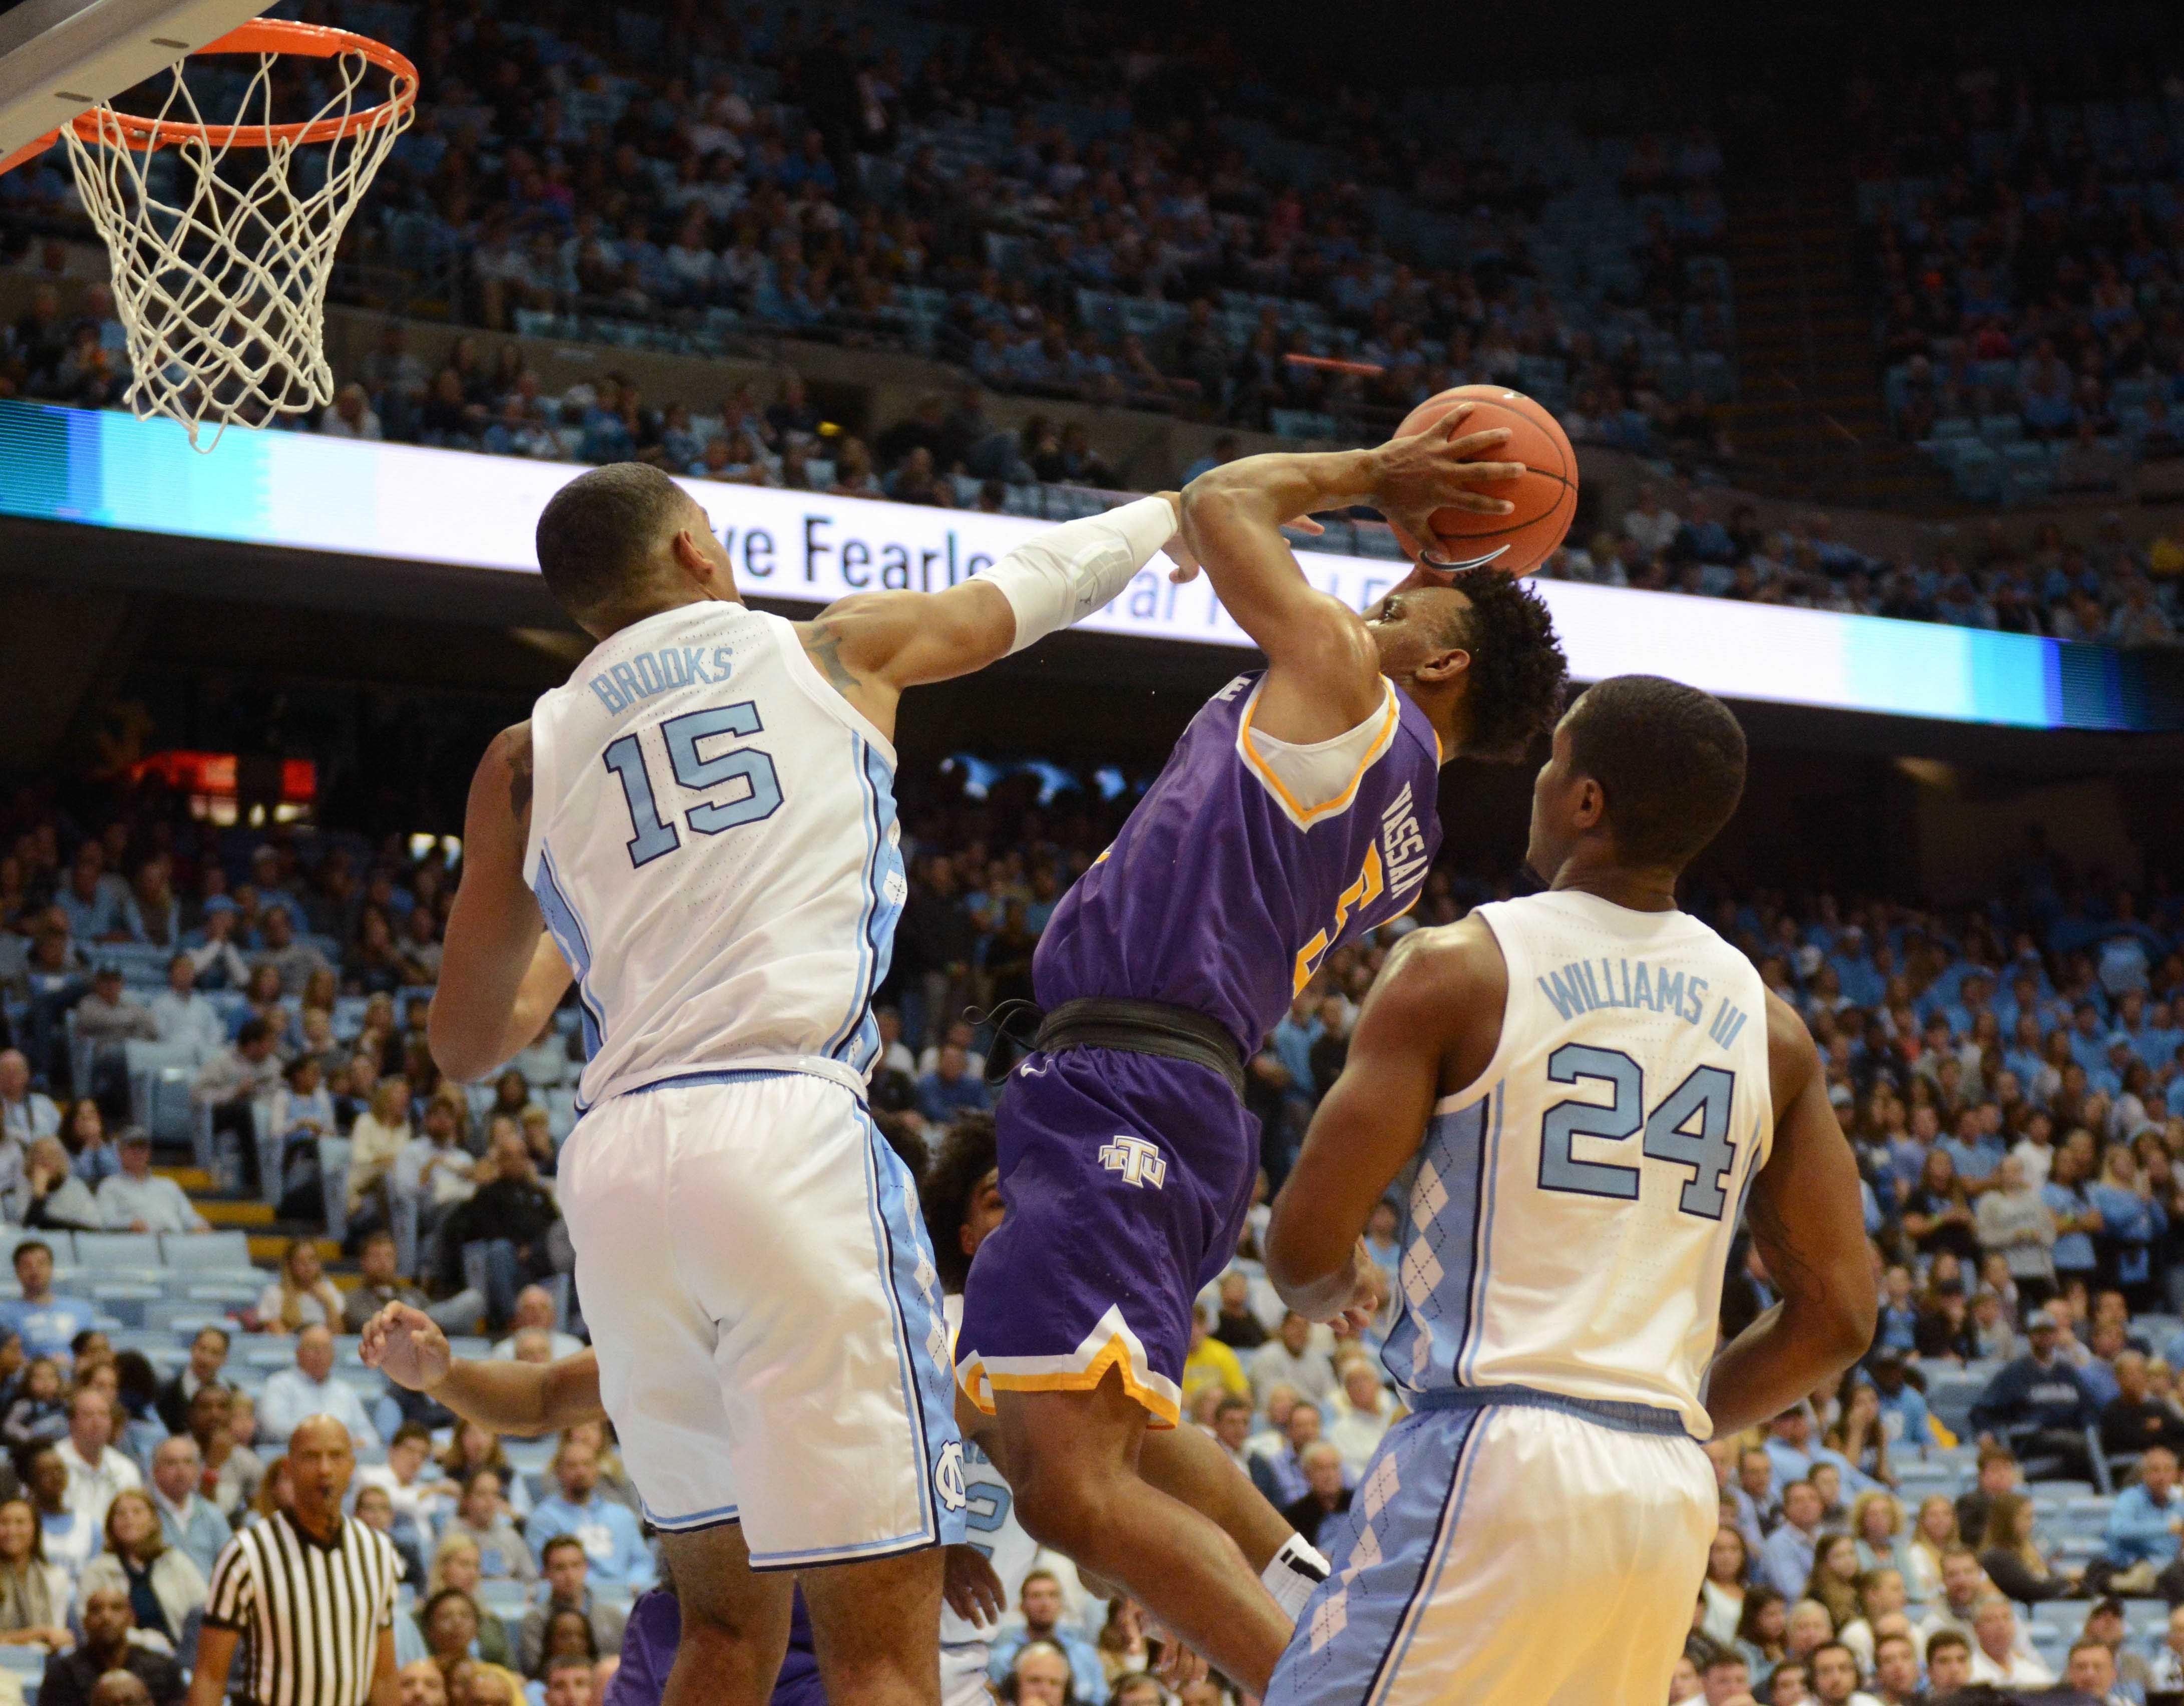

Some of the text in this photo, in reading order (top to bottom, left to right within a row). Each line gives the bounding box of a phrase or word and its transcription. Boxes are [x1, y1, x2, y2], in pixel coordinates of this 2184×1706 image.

[589, 646, 733, 716] BROOKS
[602, 700, 784, 869] 15
[1537, 958, 1709, 1025] WILLIAMS
[1537, 1042, 1737, 1222] 24
